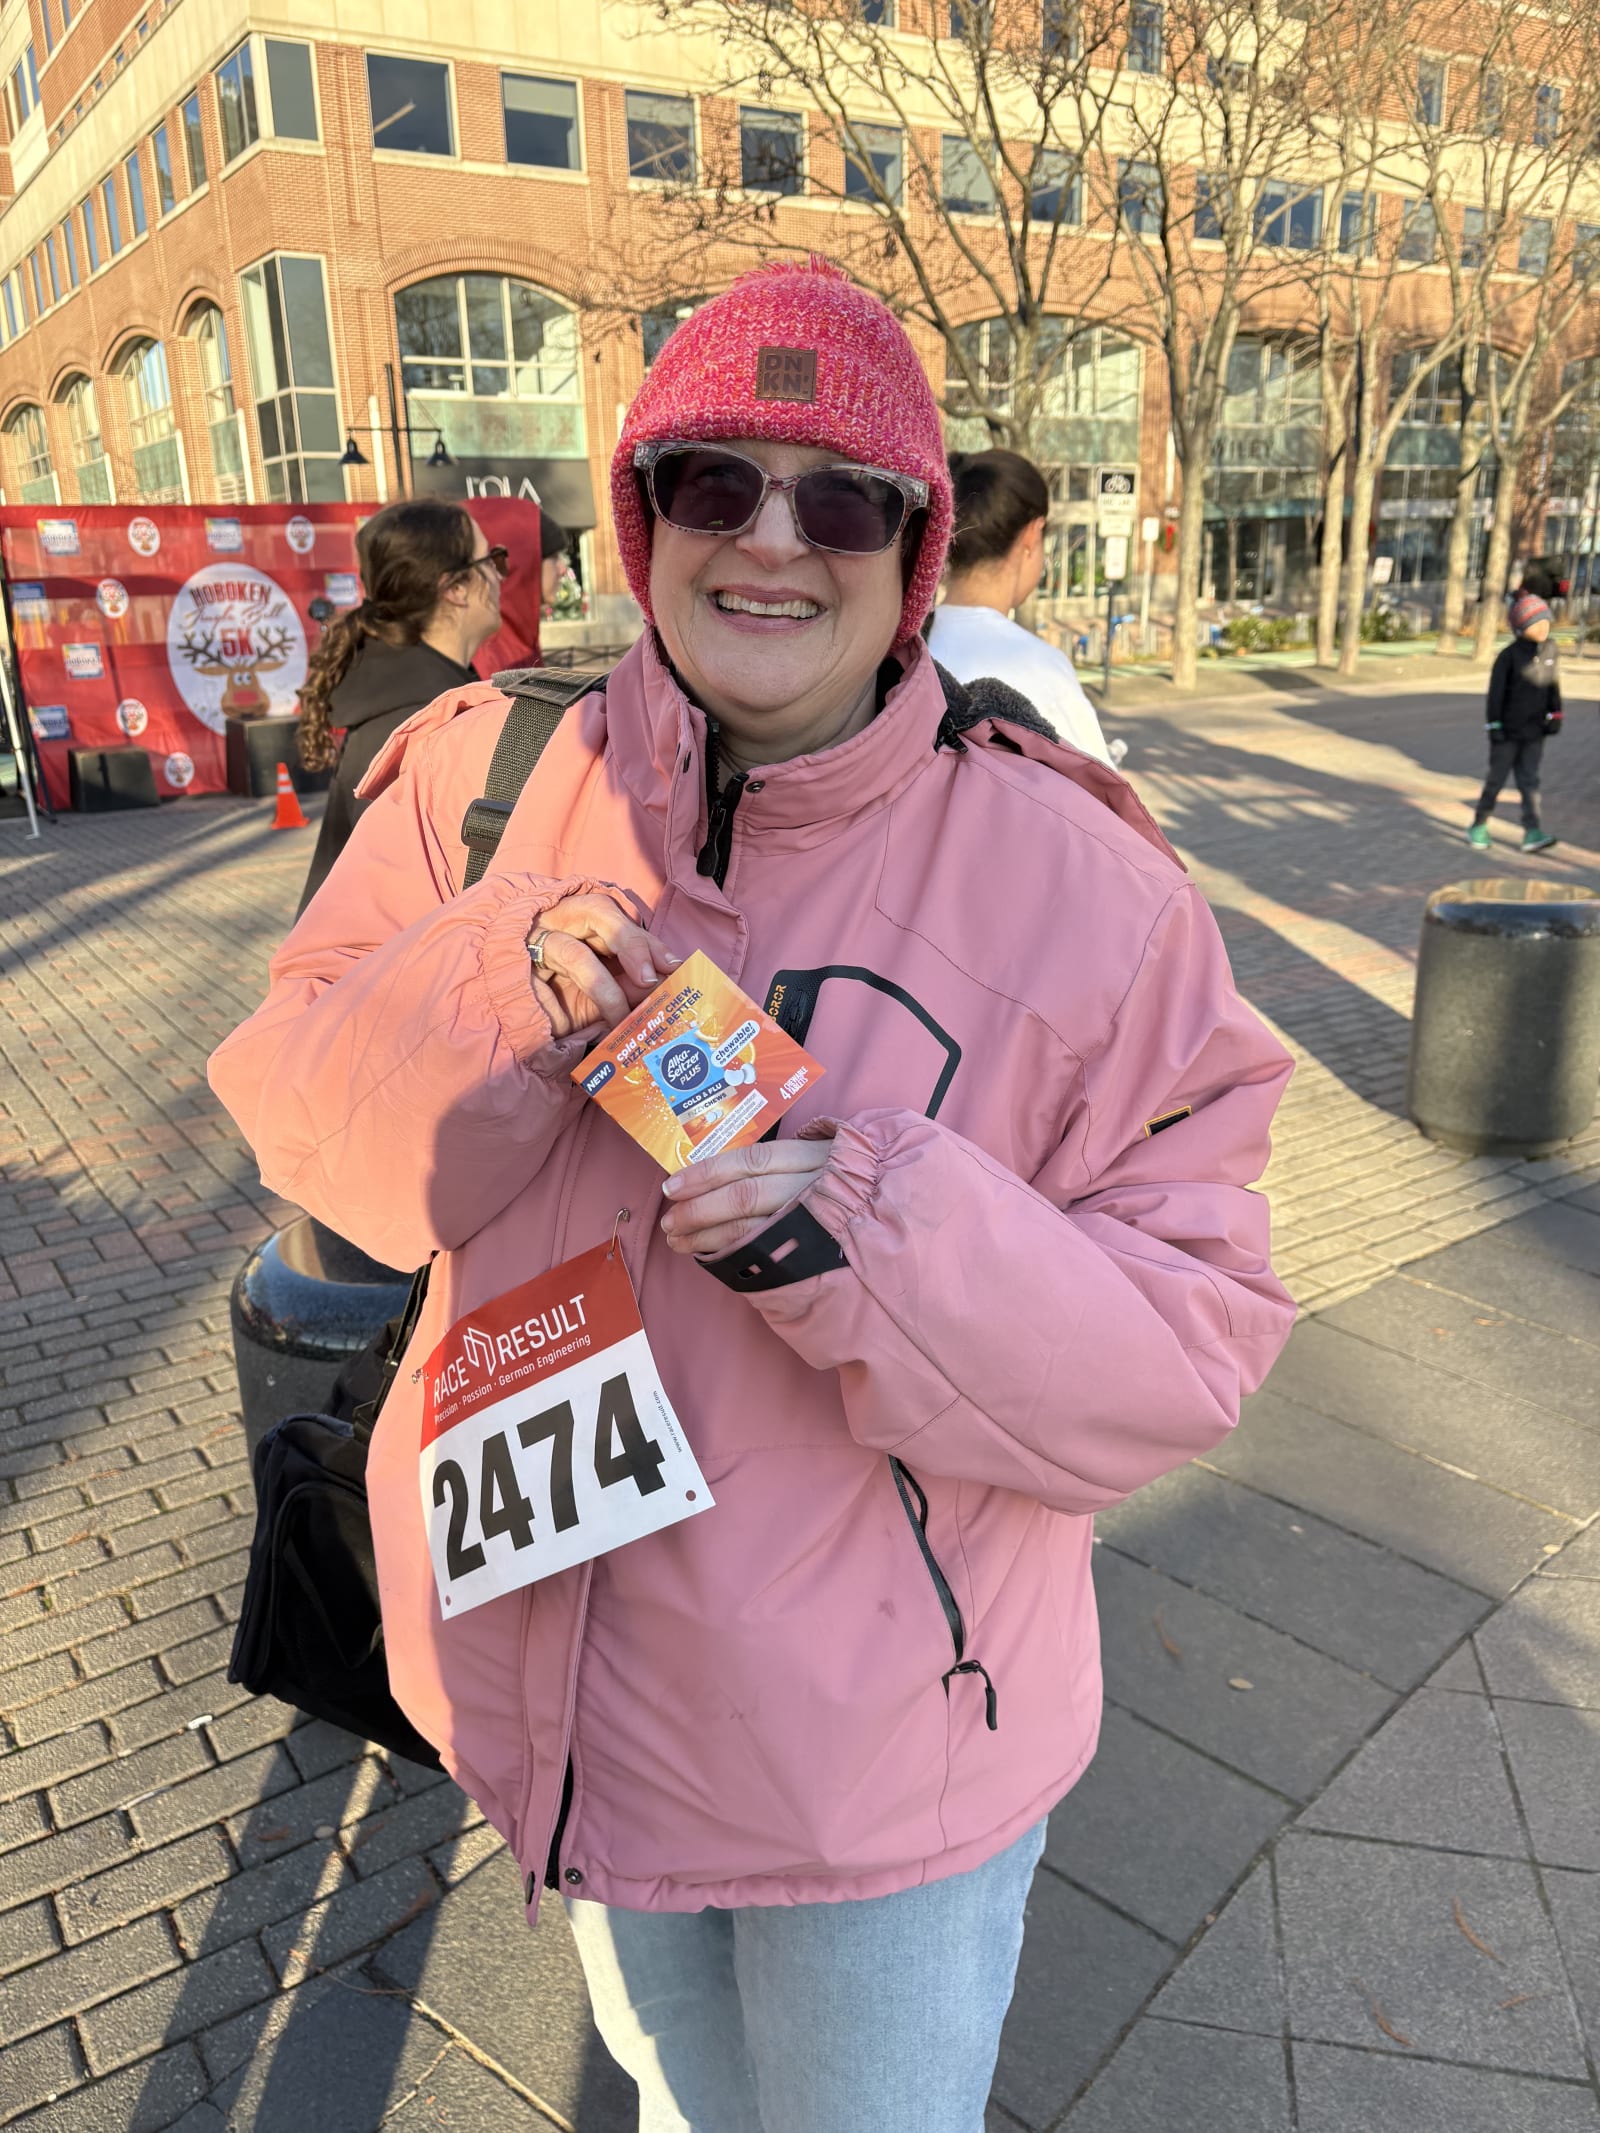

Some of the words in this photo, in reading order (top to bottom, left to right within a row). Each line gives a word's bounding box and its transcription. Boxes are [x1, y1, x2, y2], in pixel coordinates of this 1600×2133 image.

[190, 581, 271, 608] HOBOKEN
[221, 628, 254, 657] 5K
[617, 1038, 637, 1061] cold
[637, 1028, 648, 1041] or
[647, 1011, 665, 1032] flu?
[665, 986, 695, 1013] CHEW.
[622, 1046, 646, 1068] FIZZ.
[645, 1025, 668, 1047] FEEL
[666, 990, 703, 1026] BETTER!
[715, 1022, 753, 1062] chewable!
[667, 1049, 691, 1072] Alka-
[667, 1051, 700, 1082] Seltzer
[680, 1064, 701, 1085] PLUS
[586, 1064, 612, 1092] NEW!
[682, 1095, 701, 1109] COLD
[701, 1090, 708, 1098] &
[708, 1083, 722, 1094] FLU
[780, 1087, 792, 1100] 4
[433, 1356, 470, 1408] RACE
[496, 1293, 587, 1366] RESULT
[434, 1401, 458, 1425] Precision
[462, 1382, 493, 1406] Passion
[498, 1362, 535, 1387] German
[536, 1334, 592, 1369] Engineering
[432, 1372, 666, 1581] 2474
